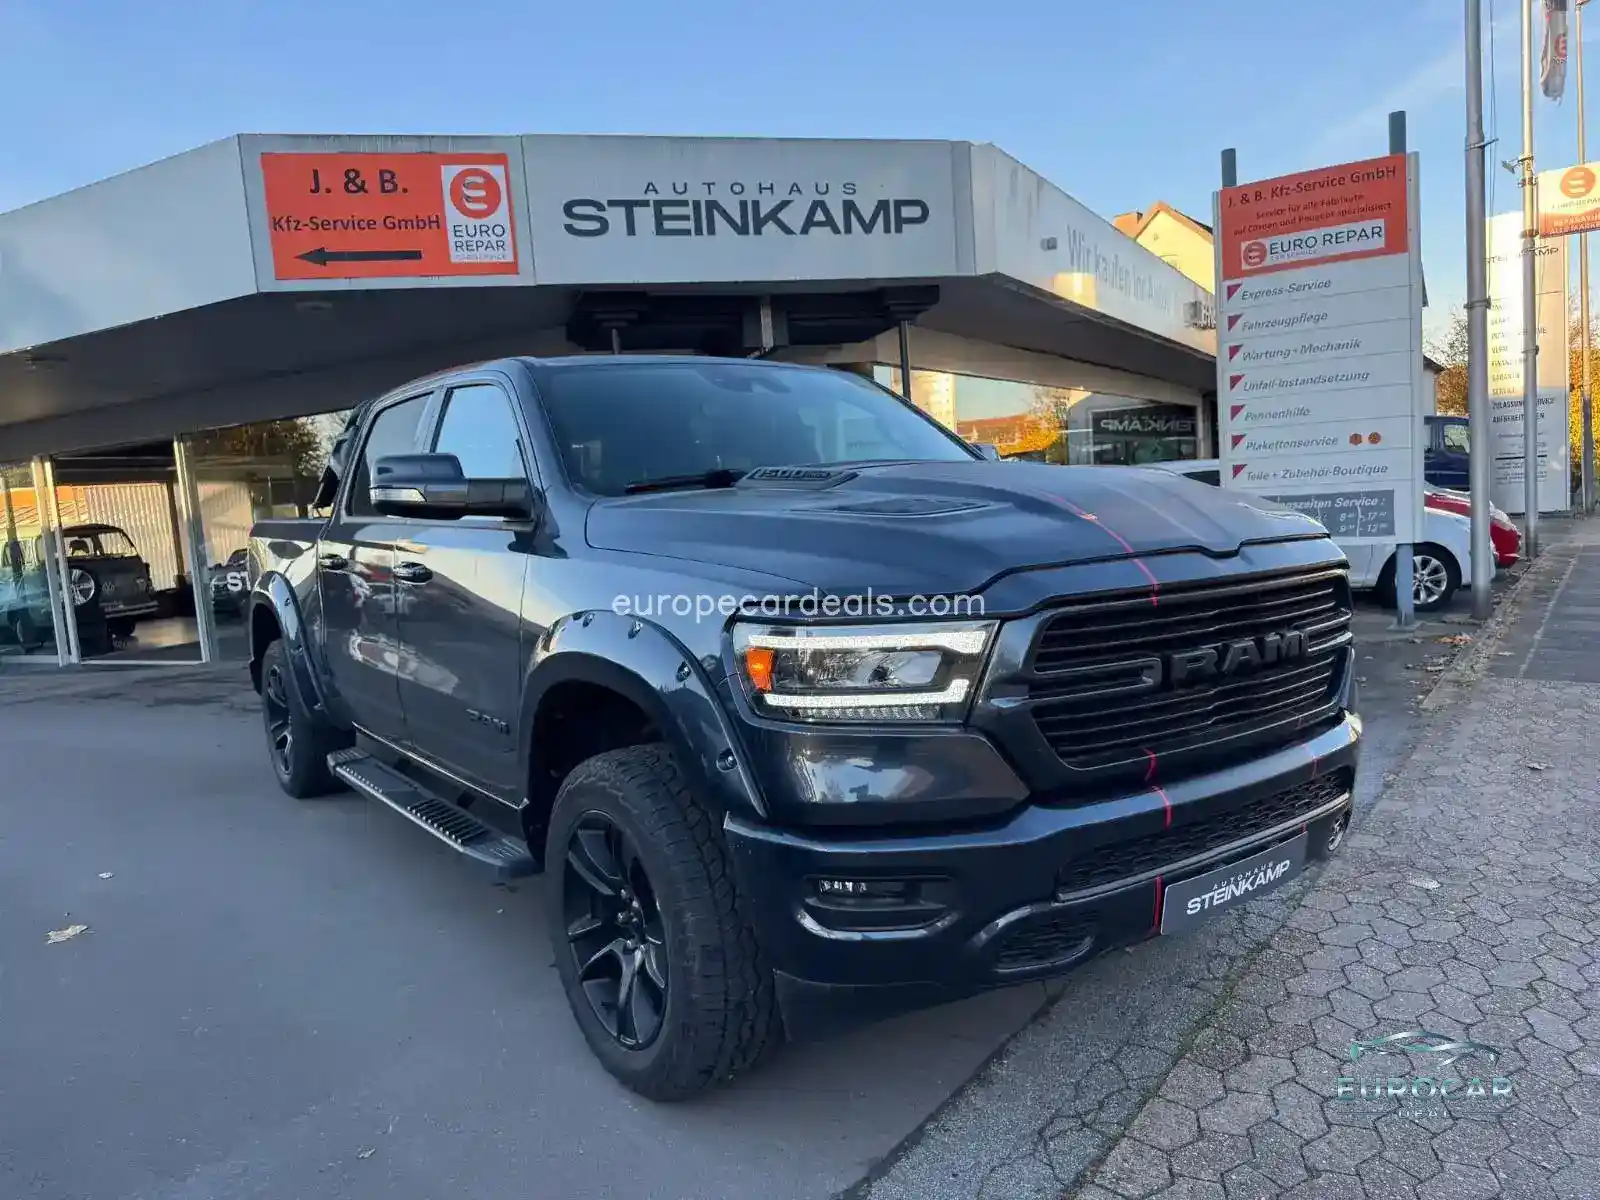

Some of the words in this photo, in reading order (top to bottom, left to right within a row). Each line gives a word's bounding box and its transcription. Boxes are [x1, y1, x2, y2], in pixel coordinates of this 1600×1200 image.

[310, 169, 331, 194] J.
[344, 168, 368, 194] &
[379, 169, 408, 194] B.
[644, 182, 857, 196] AUTOHAUS
[1227, 197, 1236, 208] J.
[1240, 193, 1250, 204] &
[1254, 190, 1267, 201] B.
[1271, 175, 1346, 199] Kfz-Service
[1350, 165, 1396, 183] GmbH
[272, 215, 377, 231] Kfz-Service
[383, 214, 440, 231] GmbH
[562, 198, 930, 237] STEINKAMP
[453, 223, 505, 238] EURO
[1270, 236, 1317, 256] EURO
[1322, 225, 1382, 247] REPAR
[455, 240, 505, 252] REPAR
[1242, 279, 1331, 300] Express-Service
[1242, 312, 1328, 332] Fahrzeugpflege
[1243, 346, 1291, 361] Wartung
[1300, 338, 1362, 355] Mechanik
[1243, 371, 1370, 392] Unfall-Instandsetzung
[1244, 407, 1311, 422] Pannenhilfe
[1246, 435, 1338, 451] Plakettenservice
[1247, 471, 1269, 481] Teile
[1335, 496, 1378, 508] Service
[1170, 630, 1313, 685] RAM
[1212, 861, 1275, 891] AUTOHAUS
[1186, 859, 1291, 916] STEINKAMP
